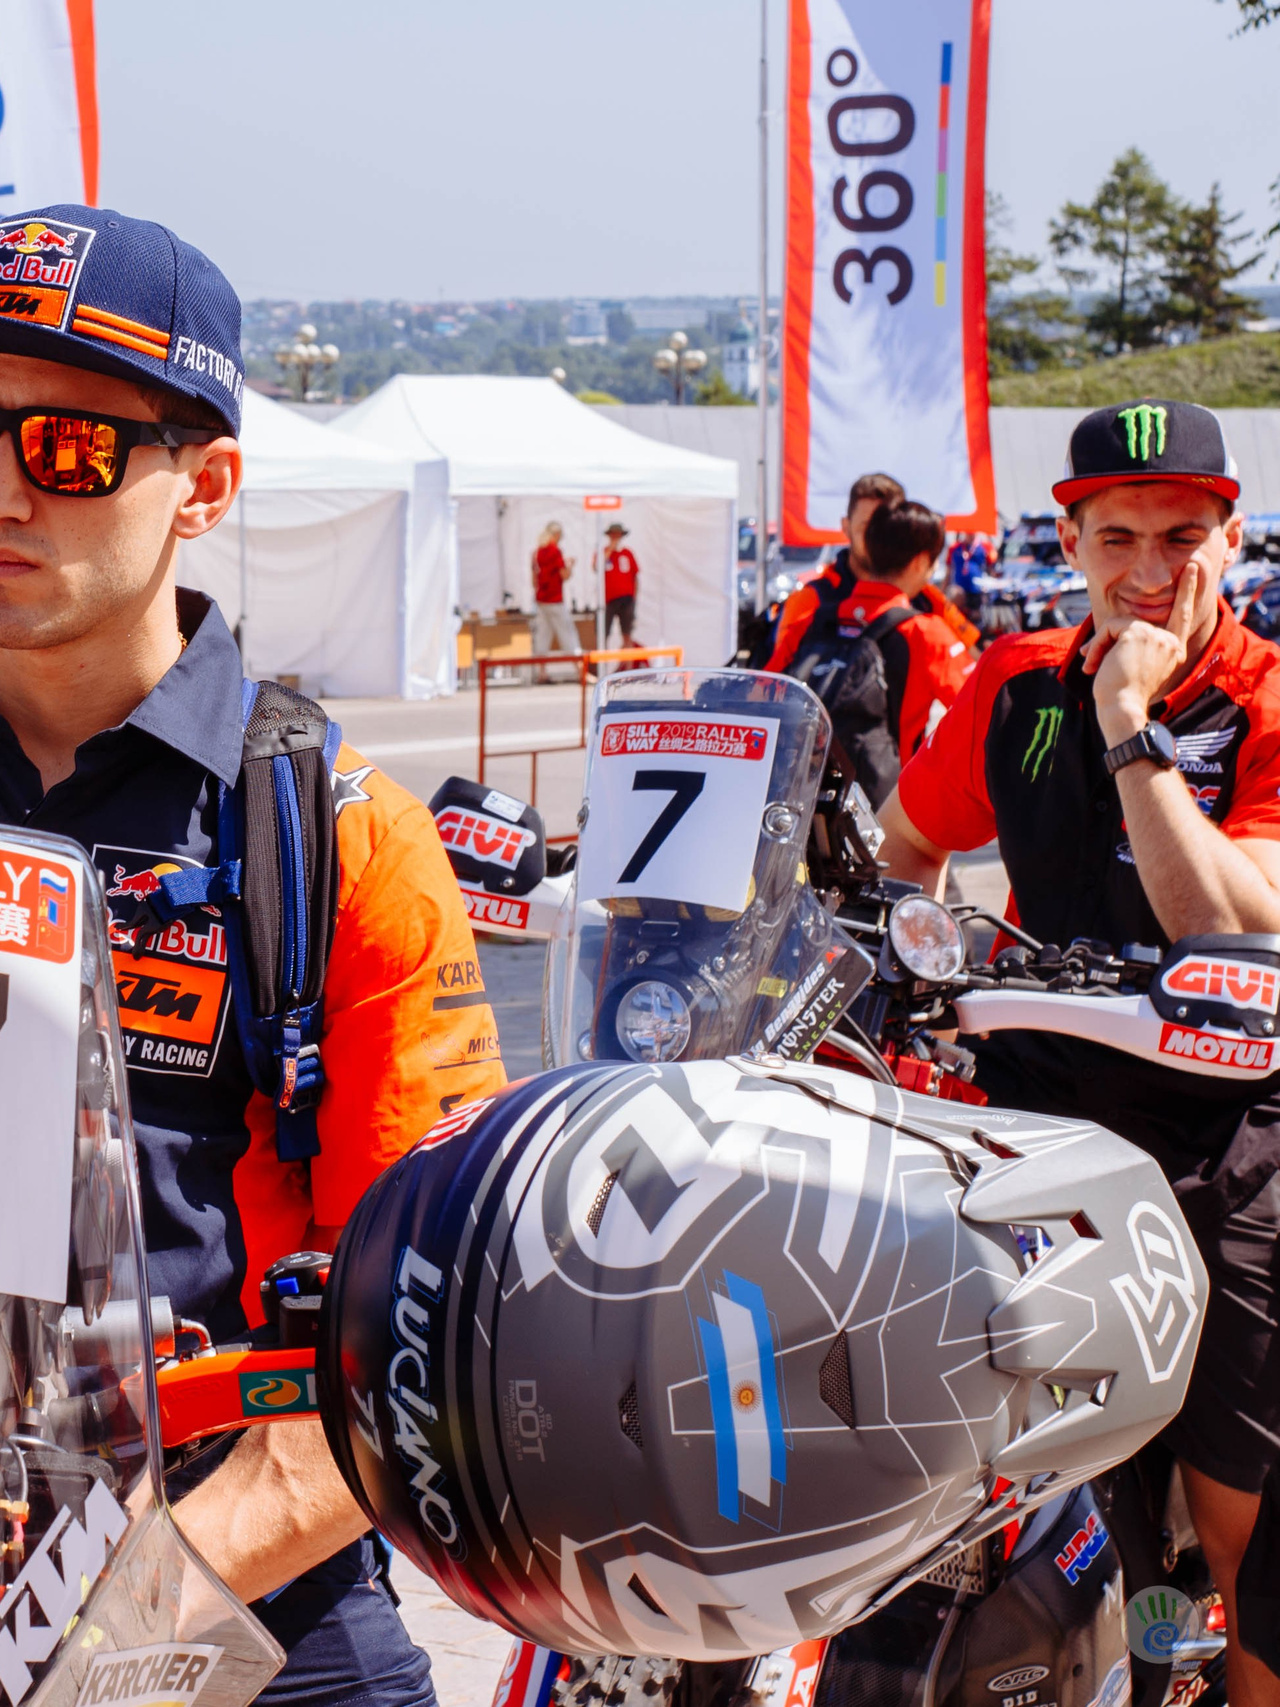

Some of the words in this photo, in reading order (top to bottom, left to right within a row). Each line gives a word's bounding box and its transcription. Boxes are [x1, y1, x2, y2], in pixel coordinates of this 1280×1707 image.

[22, 255, 77, 286] Bull
[174, 336, 236, 392] FACTORY
[626, 738, 657, 751] WAY
[627, 724, 659, 737] SILK
[662, 724, 696, 738] 2019
[696, 726, 750, 742] RALLY
[1174, 761, 1223, 773] ONDA
[435, 811, 524, 863] GIVI
[617, 769, 707, 884] 7
[158, 919, 227, 965] Bull
[436, 960, 481, 989] KÄR
[1167, 962, 1276, 1006] GIVI
[794, 1000, 842, 1060] ENERGY
[1164, 1029, 1269, 1067] MOTUL
[141, 1039, 209, 1068] RACING
[388, 1245, 458, 1545] LUCIANO
[351, 1385, 385, 1462] 77
[515, 1380, 546, 1463] DOT
[80, 1652, 209, 1707] KÄRCHER
